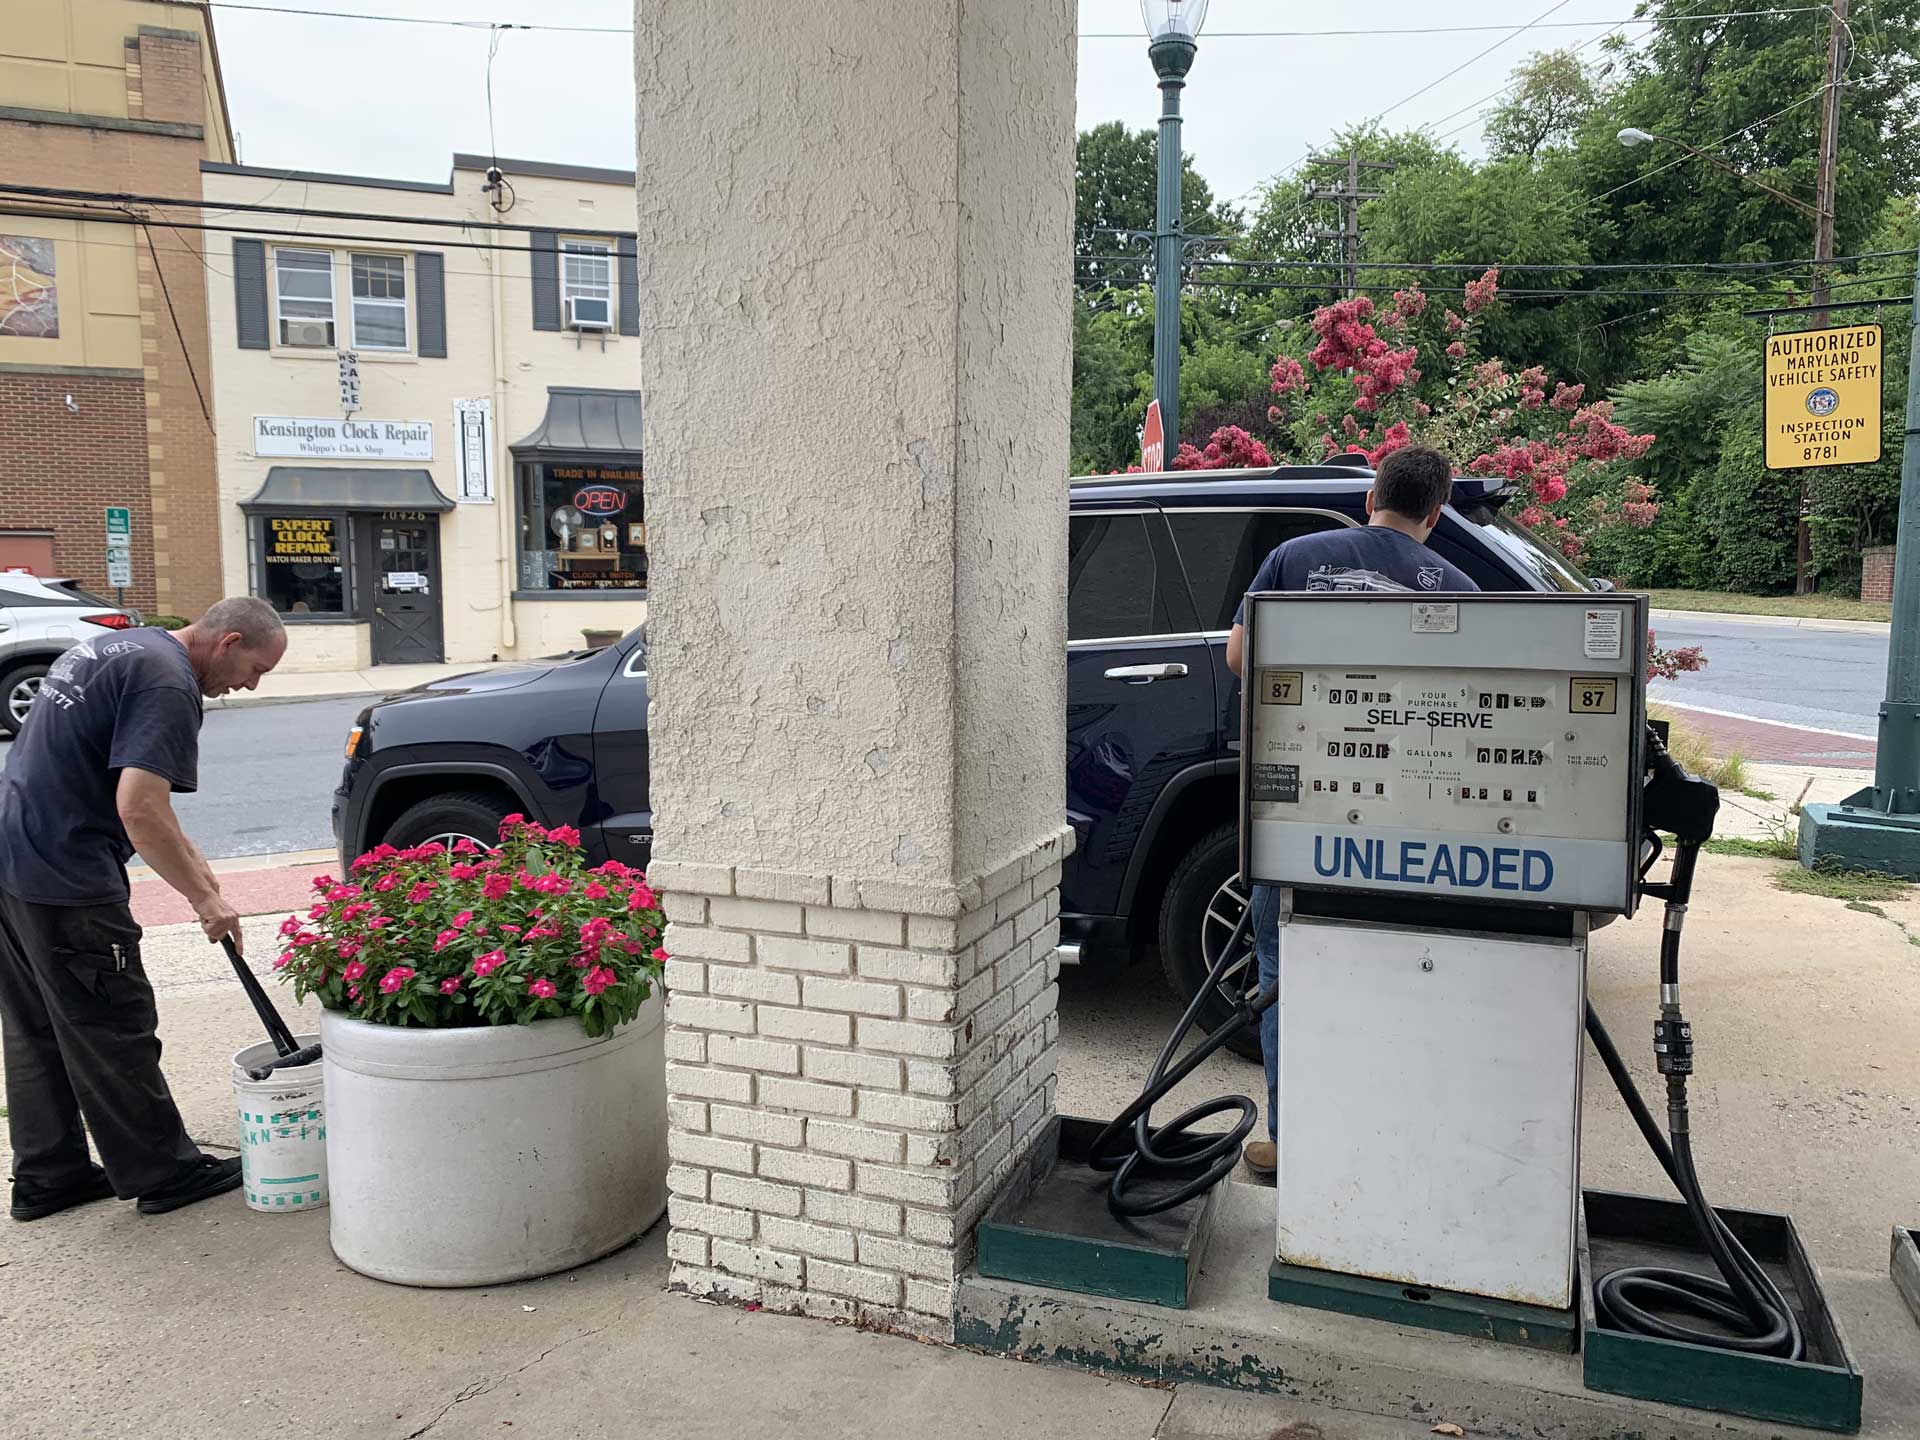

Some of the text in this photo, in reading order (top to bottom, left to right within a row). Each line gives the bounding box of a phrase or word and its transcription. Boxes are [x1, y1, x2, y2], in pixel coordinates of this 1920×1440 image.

[1771, 330, 1876, 357] AUTHORIZED
[1787, 351, 1859, 370] MARYLAND
[348, 353, 359, 404] SALE
[1770, 365, 1877, 387] VEHICLE SAFETY
[259, 419, 428, 445] Kensington Clock Repair
[1781, 418, 1865, 434] INSPECTION
[1794, 430, 1851, 444] STATION
[299, 442, 384, 456] Whippo's Clock Shop
[1803, 445, 1837, 460] 8781
[552, 469, 585, 480] TRADE
[600, 470, 643, 480] AVAILABL
[574, 491, 626, 510] OPEN
[271, 519, 332, 531] EXPERT
[277, 531, 327, 542] CLOCK
[275, 542, 331, 553] REPAIR
[266, 555, 289, 563] WATCH
[290, 555, 312, 563] MAKER
[1272, 683, 1291, 698] 87
[1421, 692, 1447, 700] YOUR
[1408, 699, 1458, 708] PURCHASE
[1582, 691, 1604, 707] 87
[1367, 708, 1493, 729] SELF-SERVE
[1407, 749, 1453, 758] GALLONS
[1267, 772, 1290, 780] Gallon
[1277, 765, 1296, 773] Price
[1313, 835, 1554, 892] UNLEADED
